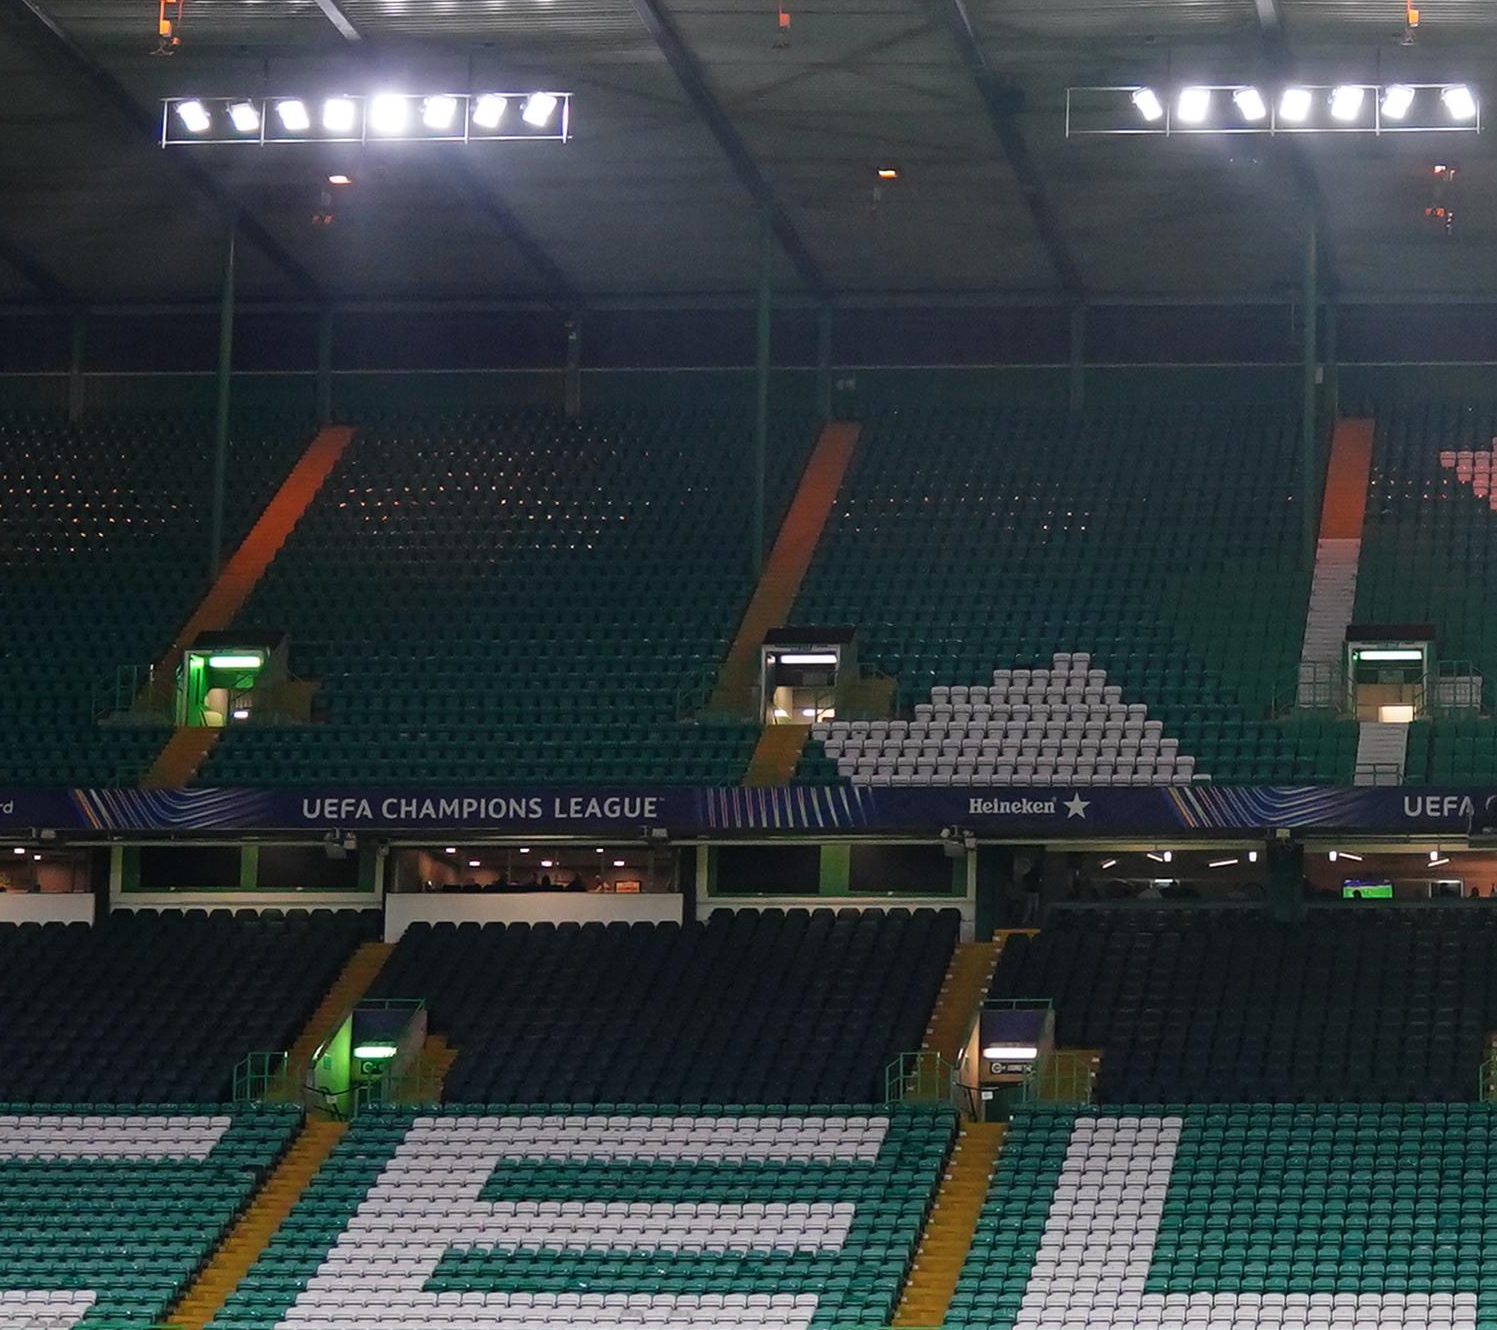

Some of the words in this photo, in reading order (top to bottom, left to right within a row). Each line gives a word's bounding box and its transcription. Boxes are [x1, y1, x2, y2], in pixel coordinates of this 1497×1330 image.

[302, 798, 373, 820] UEFA
[380, 797, 543, 820] CHAMPIONS
[554, 797, 658, 819] LEAGUE
[969, 797, 1056, 815] Heineken
[1404, 793, 1473, 818] UEFA
